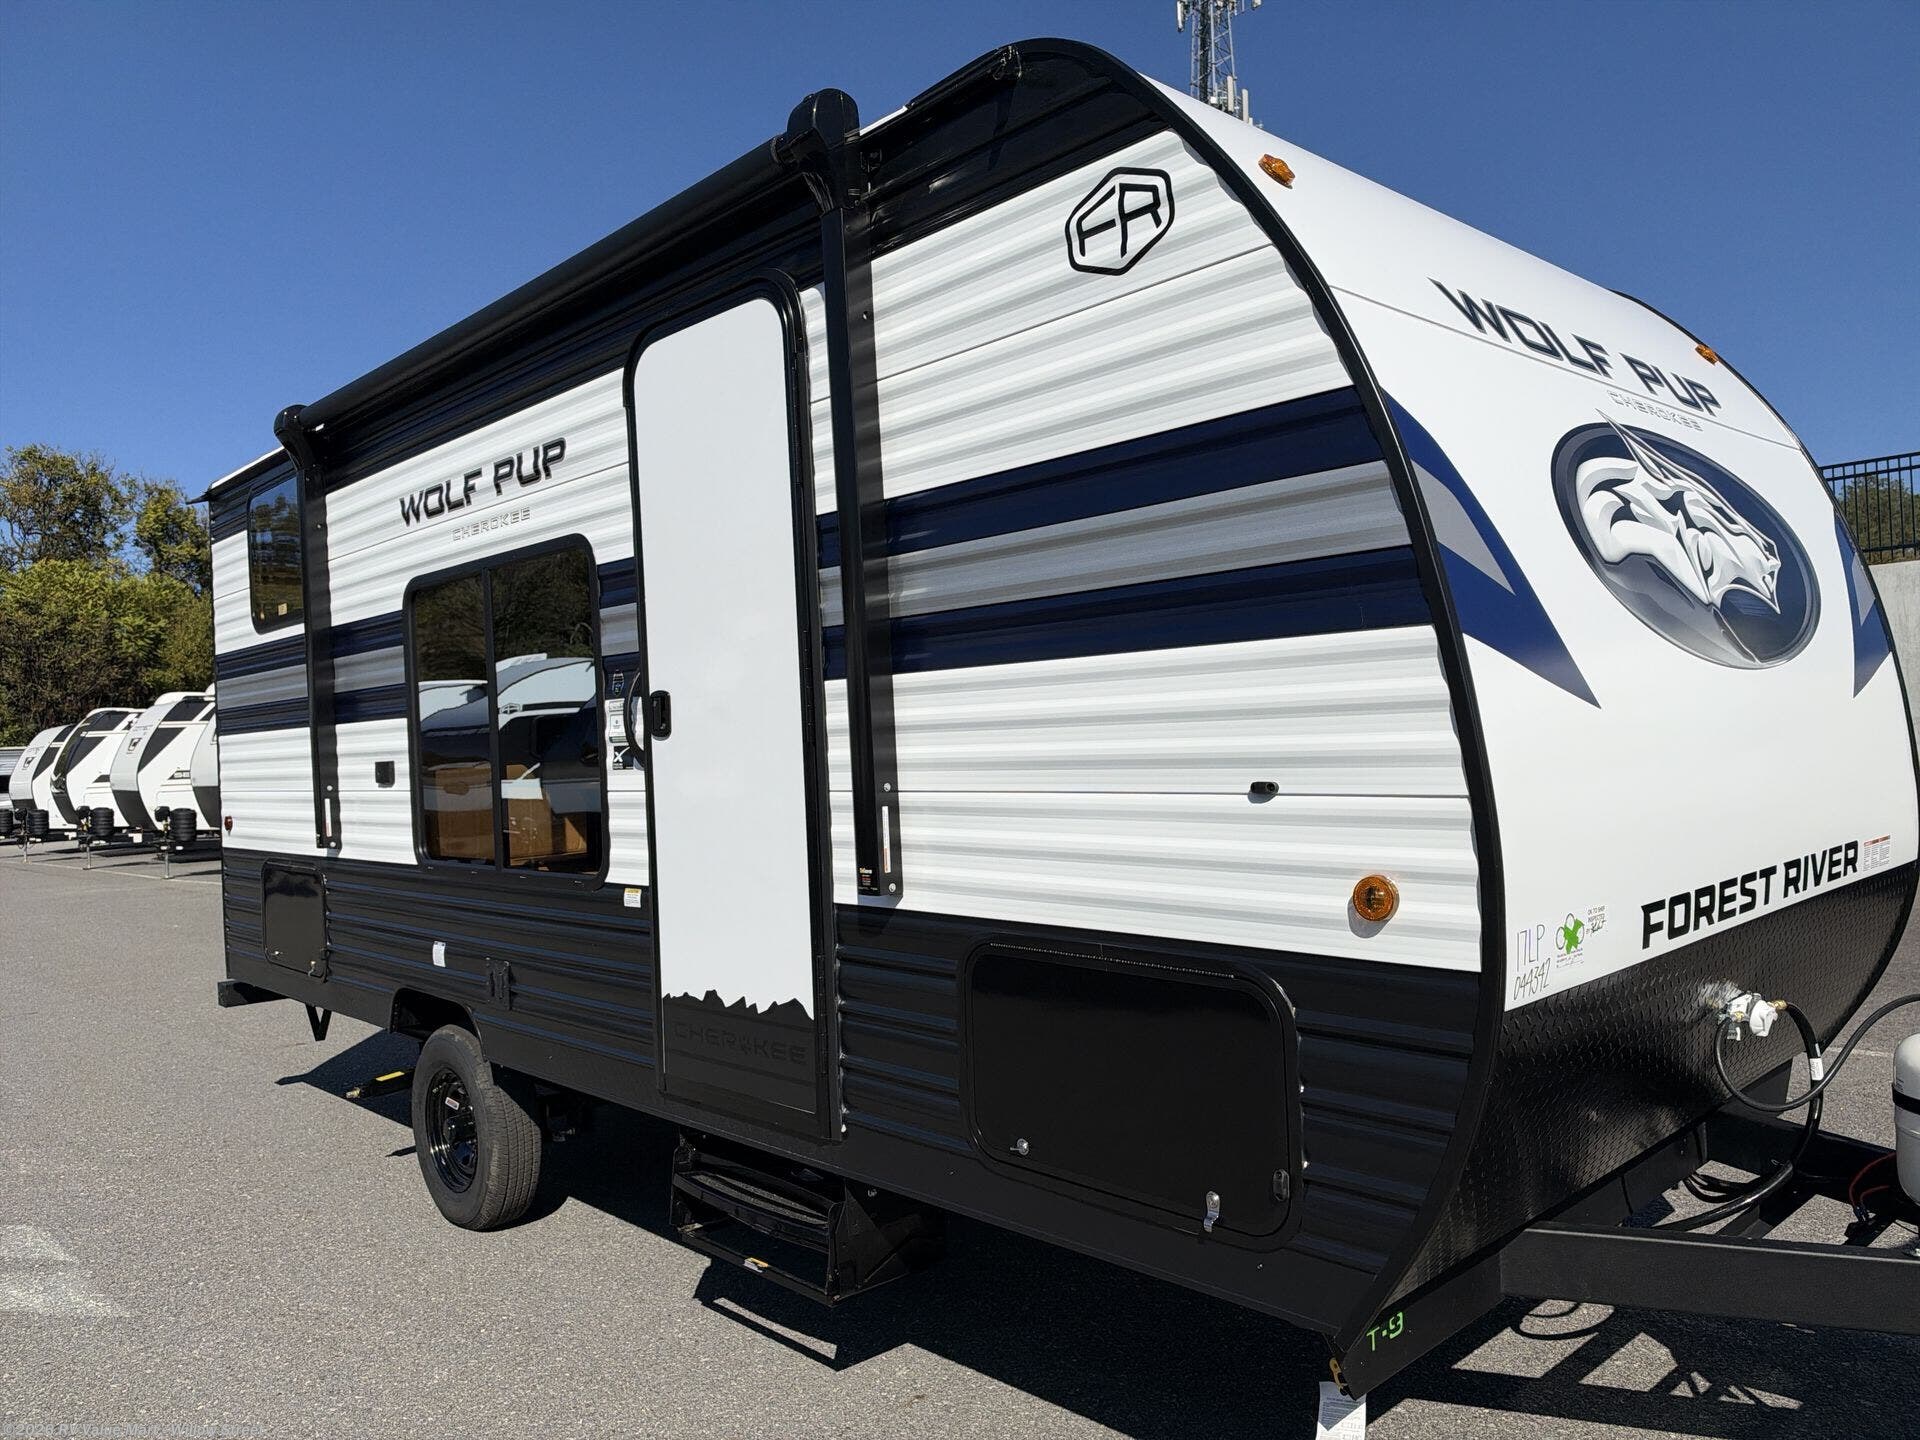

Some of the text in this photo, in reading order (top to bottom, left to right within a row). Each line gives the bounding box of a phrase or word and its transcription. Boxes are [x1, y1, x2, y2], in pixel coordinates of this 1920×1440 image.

[1427, 277, 1722, 417] WOLF PUP
[1606, 389, 1704, 432] CHEROKEE
[399, 437, 567, 527] WOLF PUP
[451, 507, 531, 541] CHEROKEE
[1640, 865, 1778, 950] FOREST
[1783, 840, 1859, 899] RIVER
